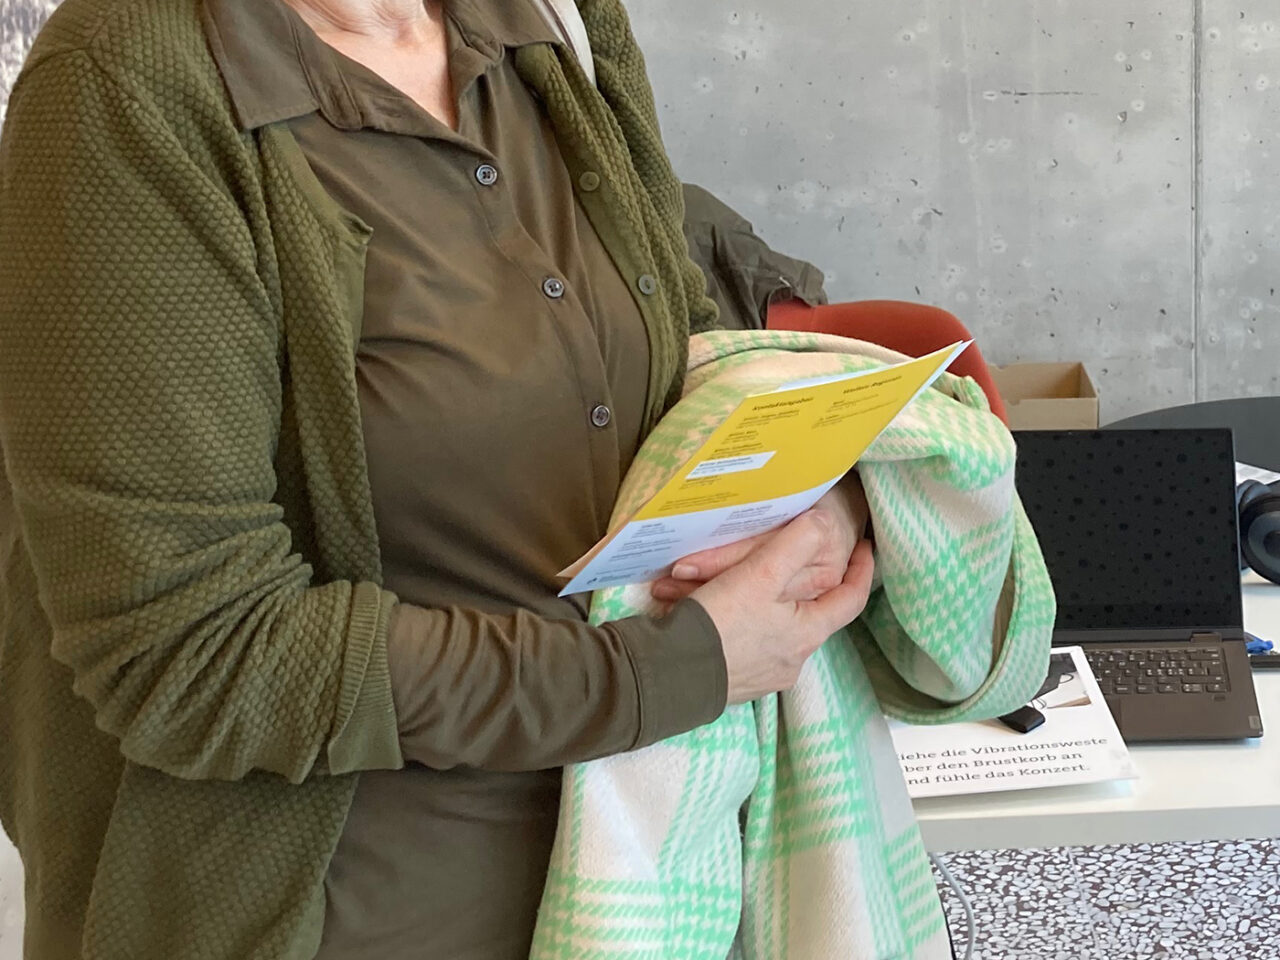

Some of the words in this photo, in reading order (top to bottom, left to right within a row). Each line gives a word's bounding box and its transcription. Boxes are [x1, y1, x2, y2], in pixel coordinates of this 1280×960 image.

[899, 751, 937, 761] iehe
[940, 748, 967, 758] die
[970, 737, 1109, 755] Vibrationsweste
[903, 763, 933, 773] ber
[936, 761, 969, 771] den
[973, 752, 1057, 768] Brustkorb
[1061, 751, 1083, 761] an
[907, 775, 931, 785] nd
[935, 771, 981, 783] fühle
[984, 768, 1015, 779] das
